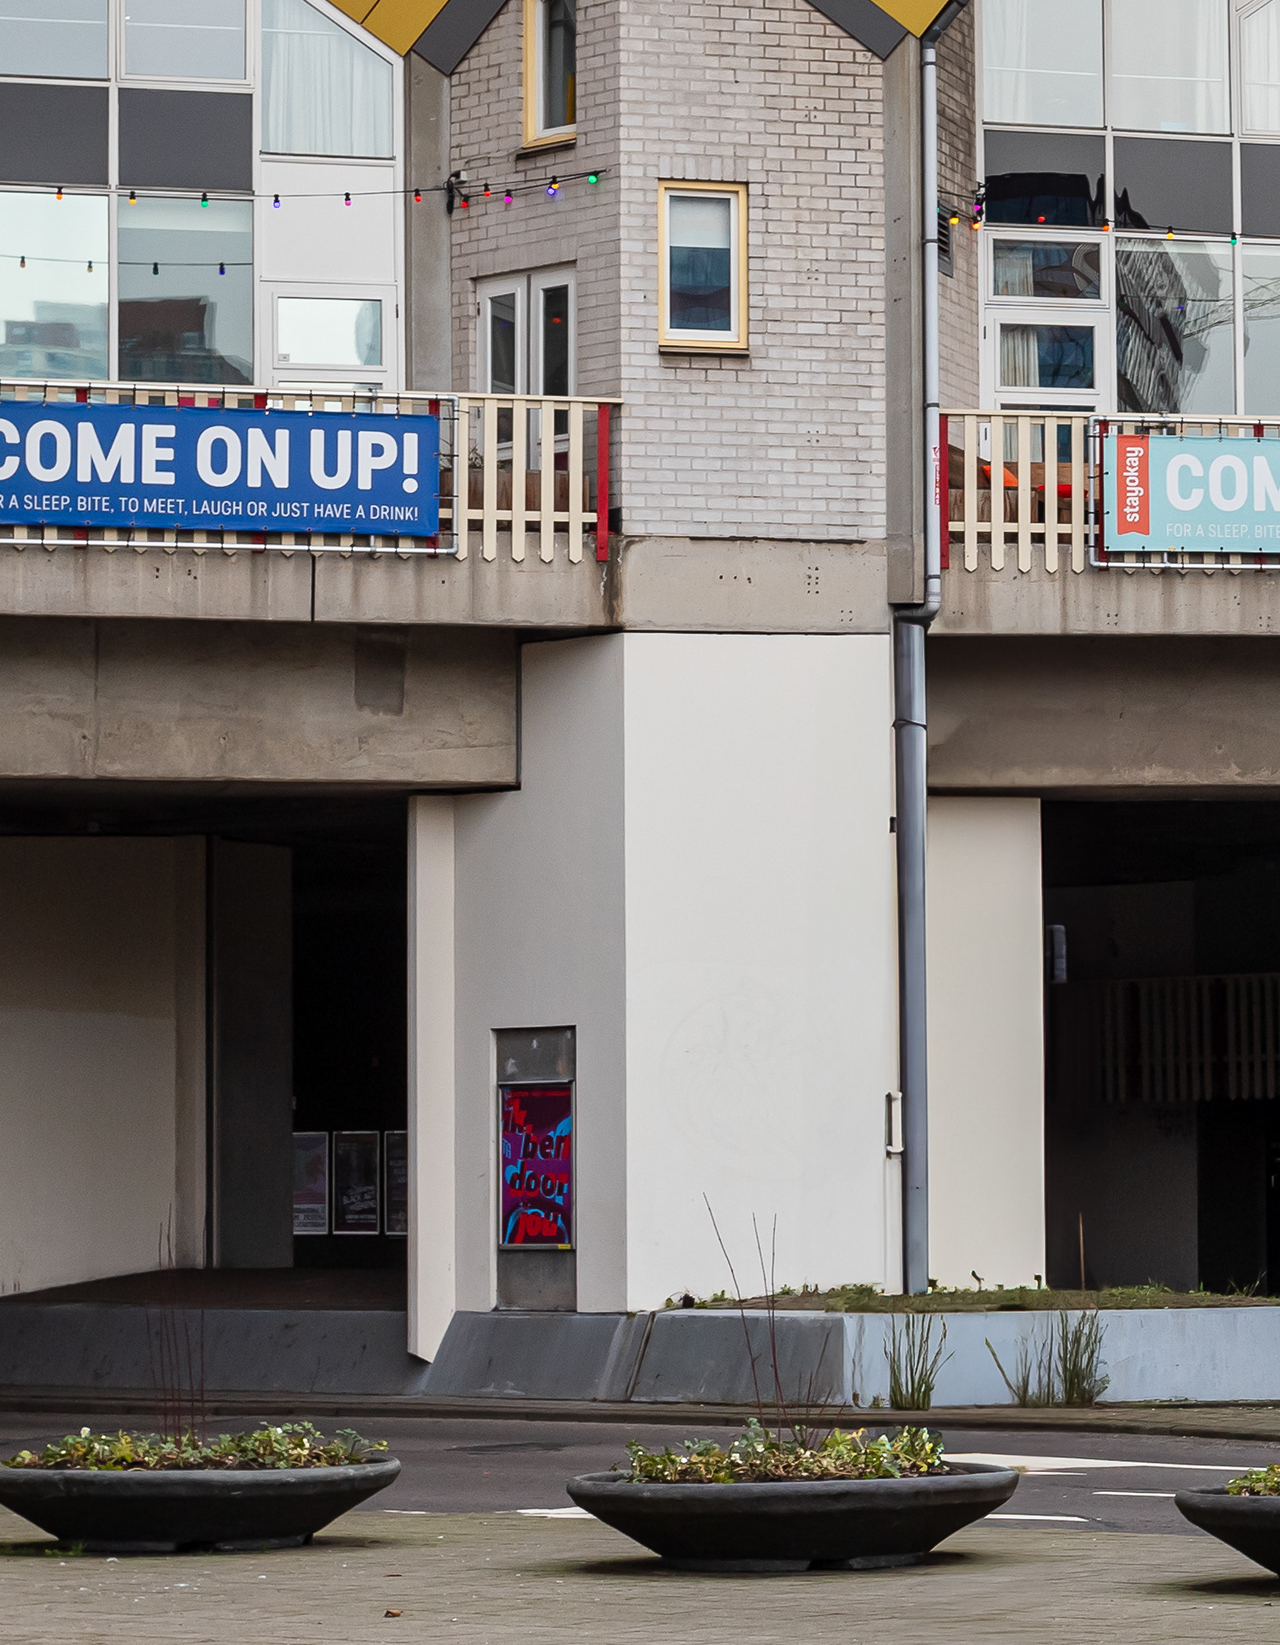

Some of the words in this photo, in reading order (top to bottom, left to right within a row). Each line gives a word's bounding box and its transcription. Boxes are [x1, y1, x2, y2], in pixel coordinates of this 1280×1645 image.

[196, 425, 290, 489] ON
[309, 429, 419, 494] UP!
[1123, 446, 1144, 522] stayokay
[9, 495, 19, 509] A
[118, 498, 139, 512] TO
[192, 500, 243, 516] LAUGH
[247, 501, 268, 516] OR
[271, 502, 310, 517] JUST
[314, 504, 352, 519] HAVE
[355, 505, 366, 519] A
[370, 505, 419, 521] DRINK!
[1166, 523, 1192, 537] FOR
[1195, 524, 1205, 537] A
